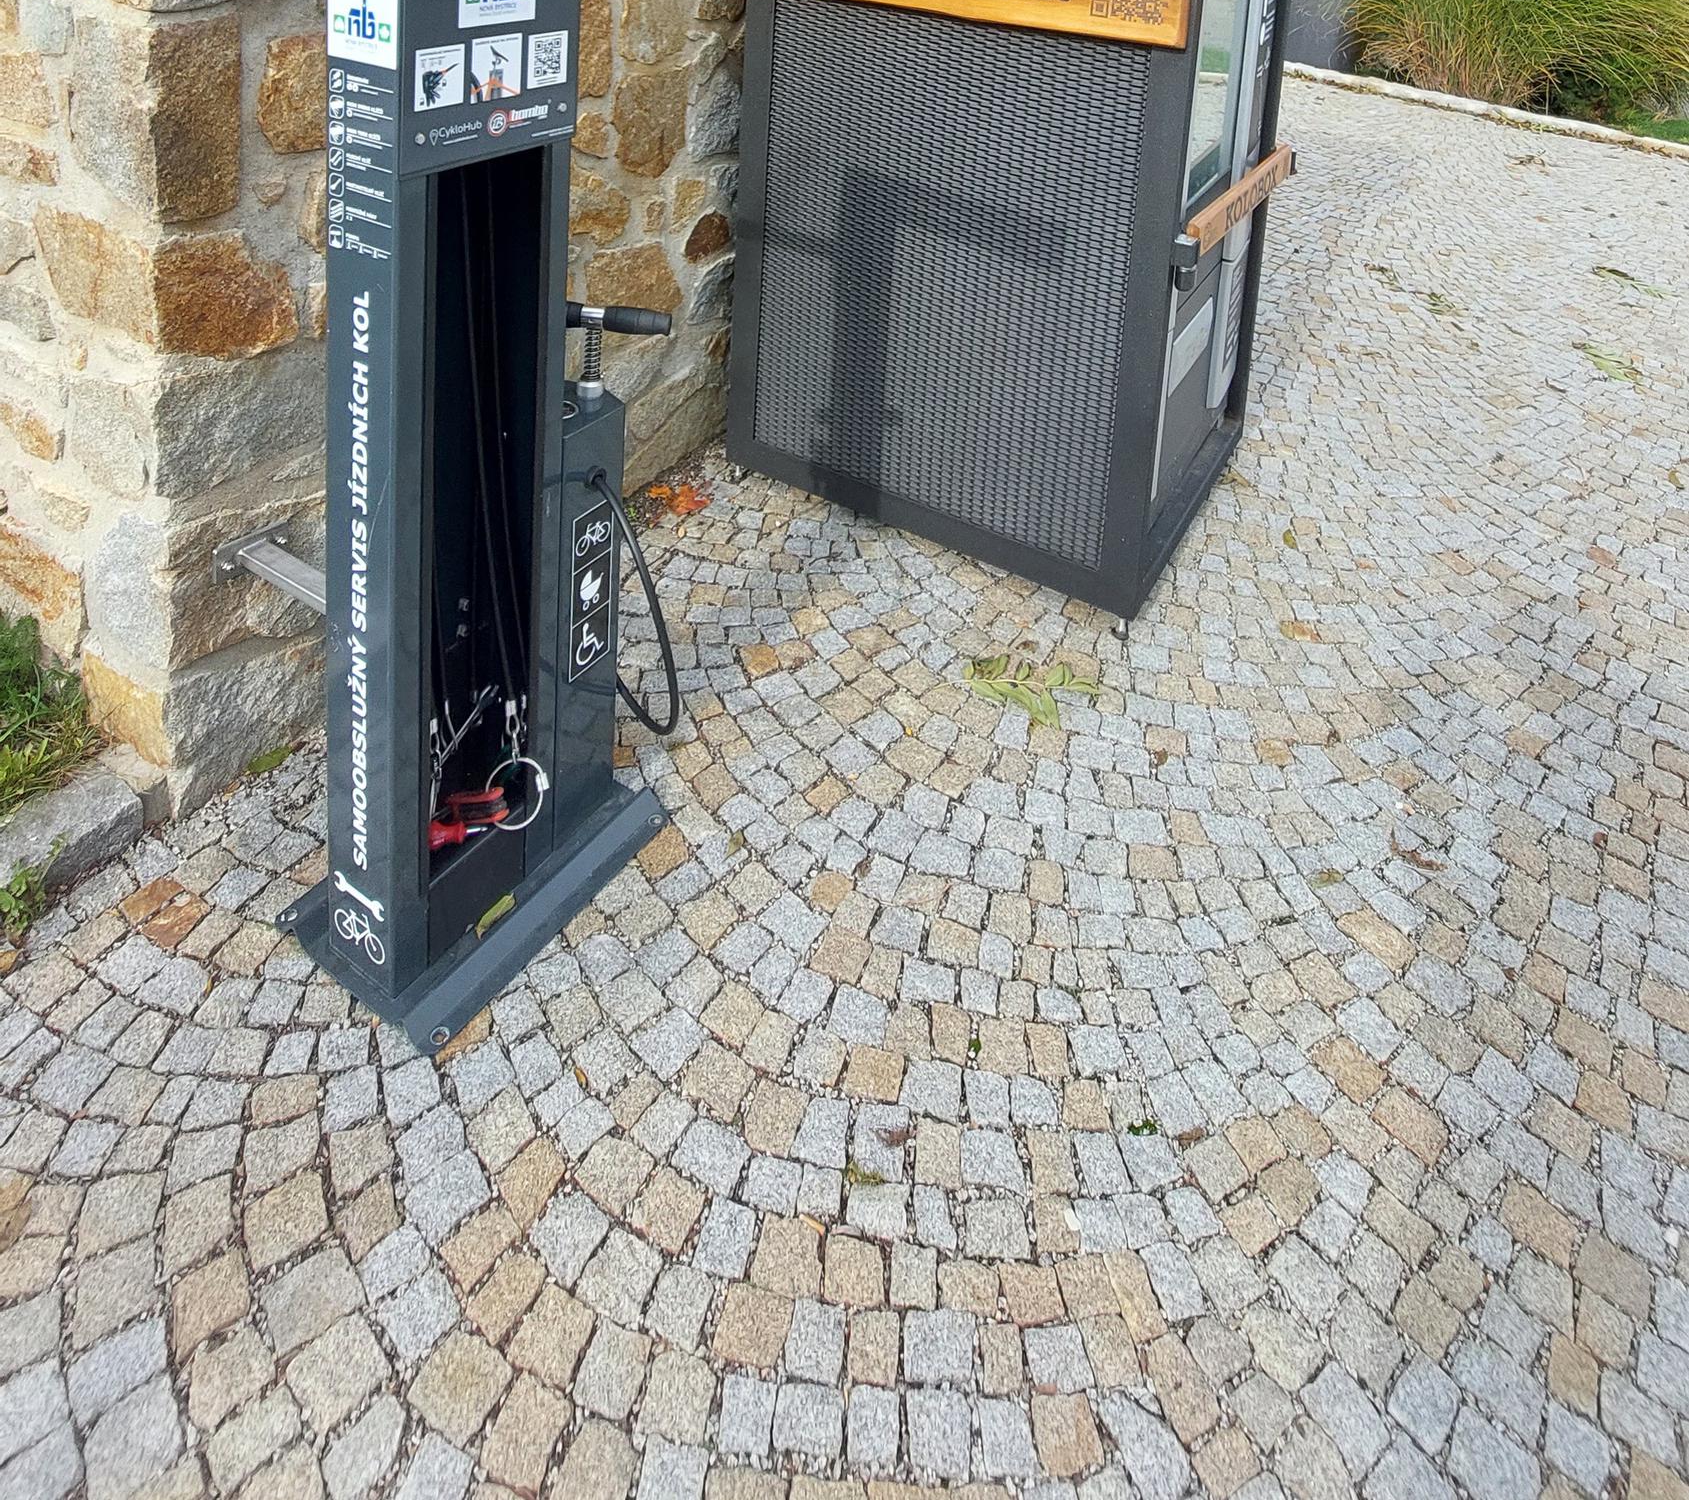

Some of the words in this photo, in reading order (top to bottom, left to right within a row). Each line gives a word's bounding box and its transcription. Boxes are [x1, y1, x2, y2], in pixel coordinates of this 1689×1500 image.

[438, 120, 483, 138] CykloHub
[1224, 163, 1279, 232] KOLOBOX
[352, 290, 370, 354] KOL
[347, 360, 369, 516] JÍZDNÍCH
[351, 519, 368, 633] SERVIS
[347, 635, 368, 871] SAMOOBSLUŽNÝ
